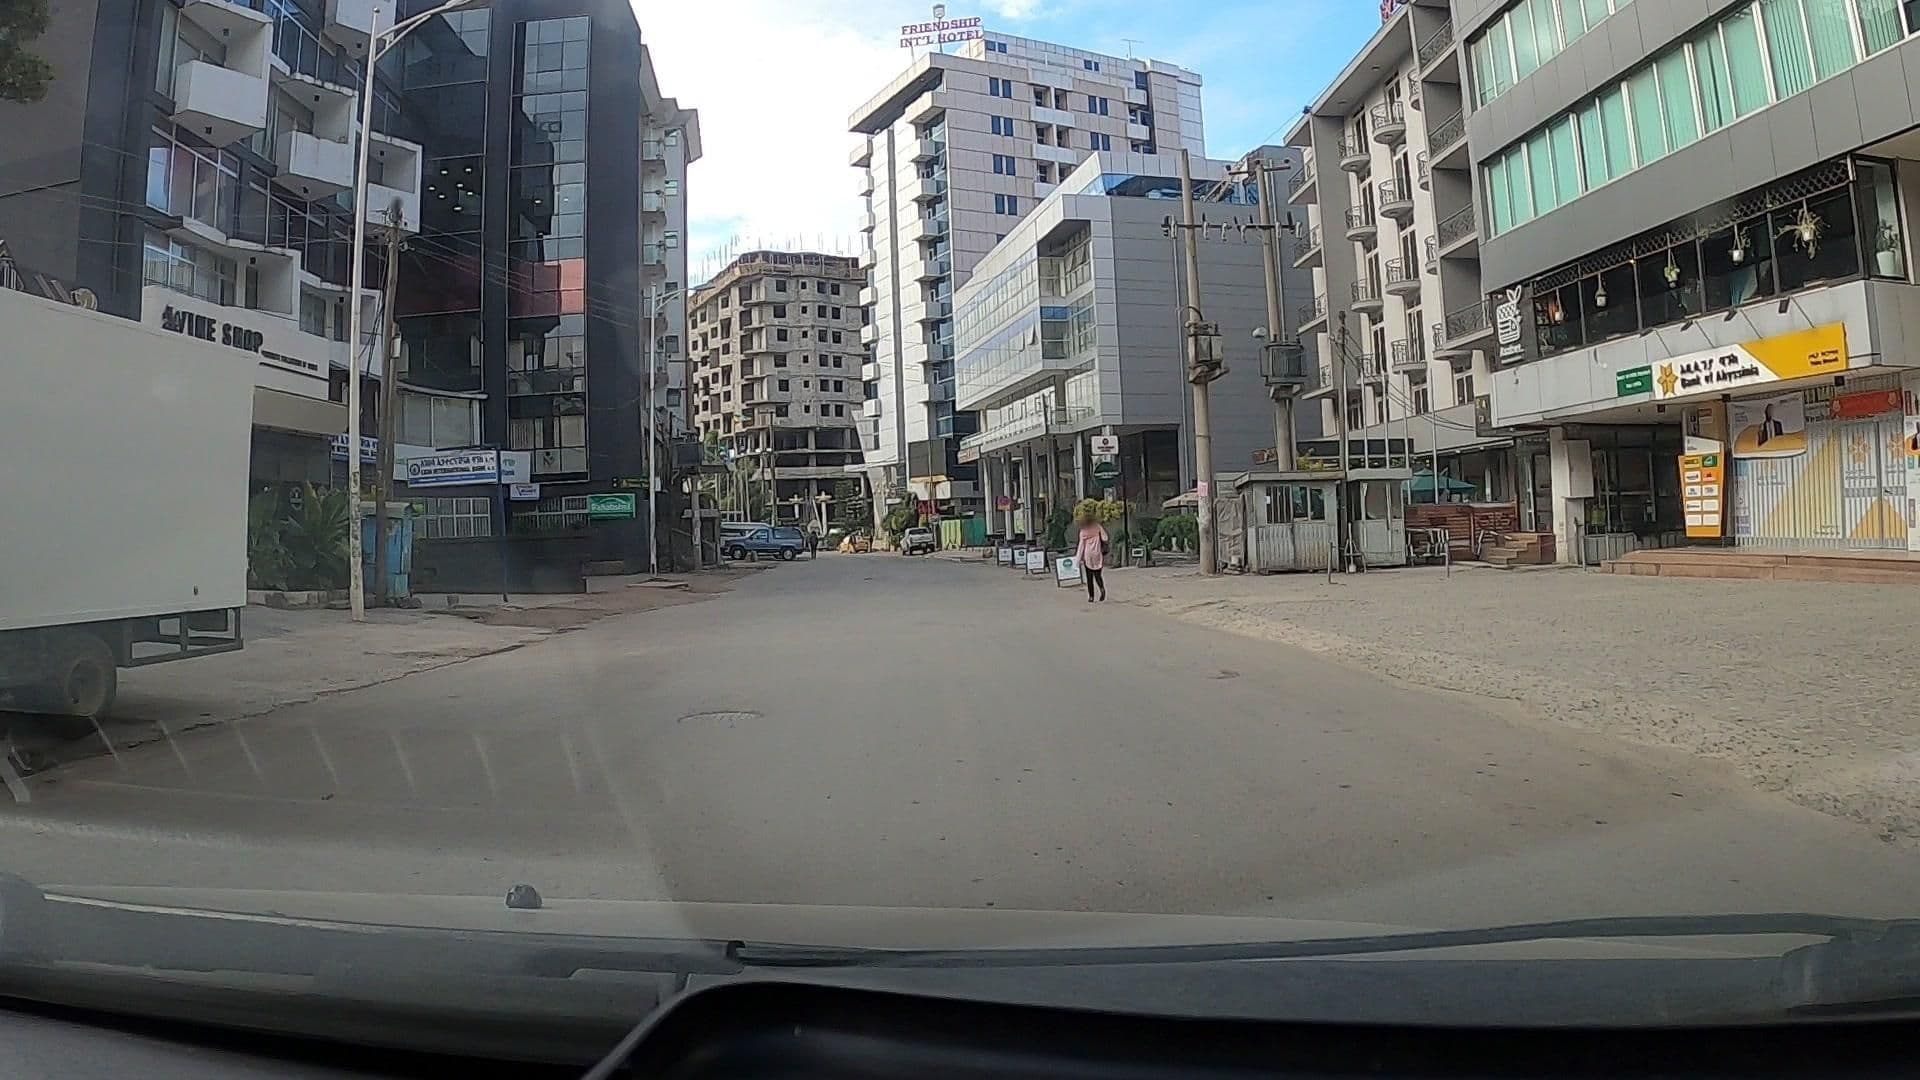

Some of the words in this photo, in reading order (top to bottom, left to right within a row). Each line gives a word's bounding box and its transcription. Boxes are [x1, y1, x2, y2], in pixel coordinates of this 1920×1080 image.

[902, 17, 981, 35] FRIENDSHIP
[900, 35, 933, 48] INT'L
[938, 29, 983, 43] HOTEL
[222, 323, 263, 352] SHOP
[1681, 376, 1701, 389] Bank
[1705, 373, 1714, 384] of
